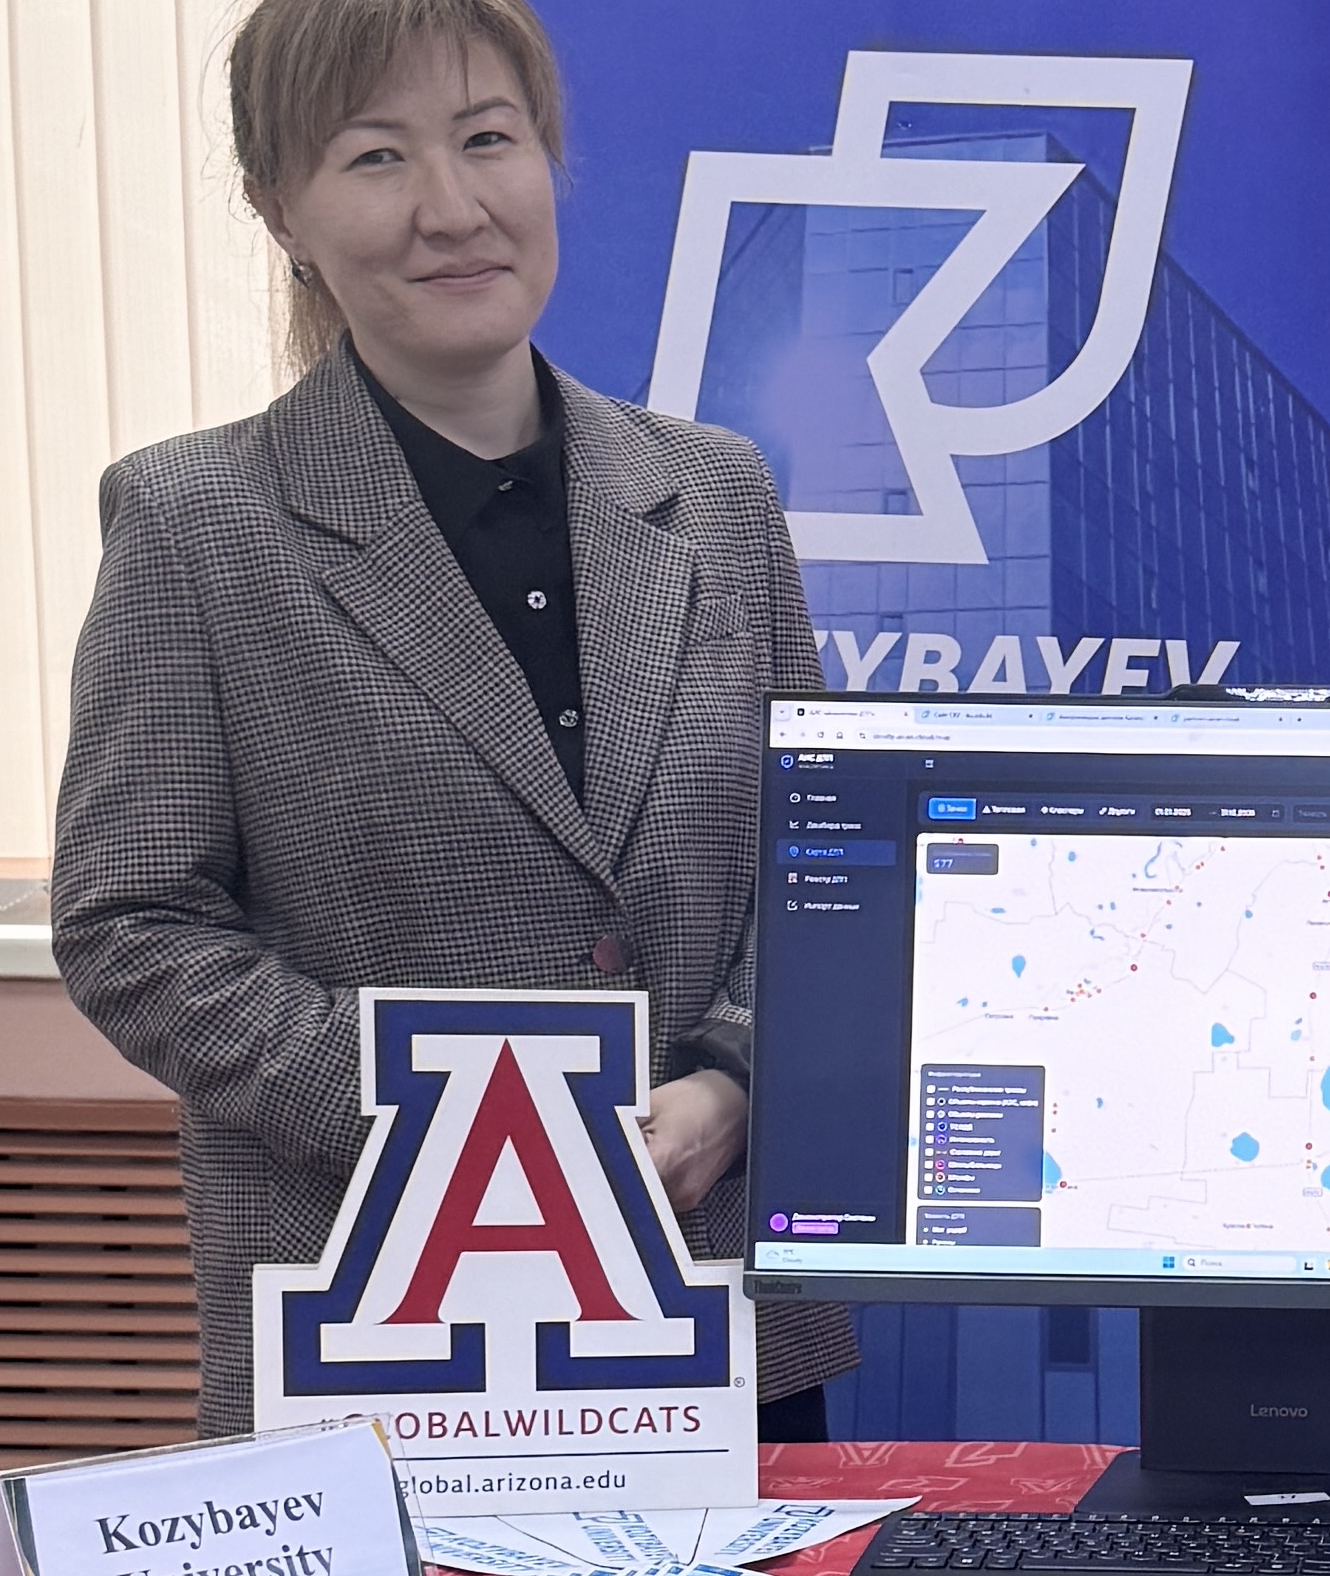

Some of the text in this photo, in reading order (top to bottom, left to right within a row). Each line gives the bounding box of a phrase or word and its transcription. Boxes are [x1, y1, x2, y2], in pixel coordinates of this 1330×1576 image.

[813, 630, 1240, 695] YBAYEV
[283, 1001, 730, 1396] A
[321, 1405, 702, 1441] OBALWILDCATS
[1250, 1404, 1308, 1417] Lenovo
[398, 1470, 626, 1498] global.arizona.edu
[94, 1491, 323, 1555] Kozybayev
